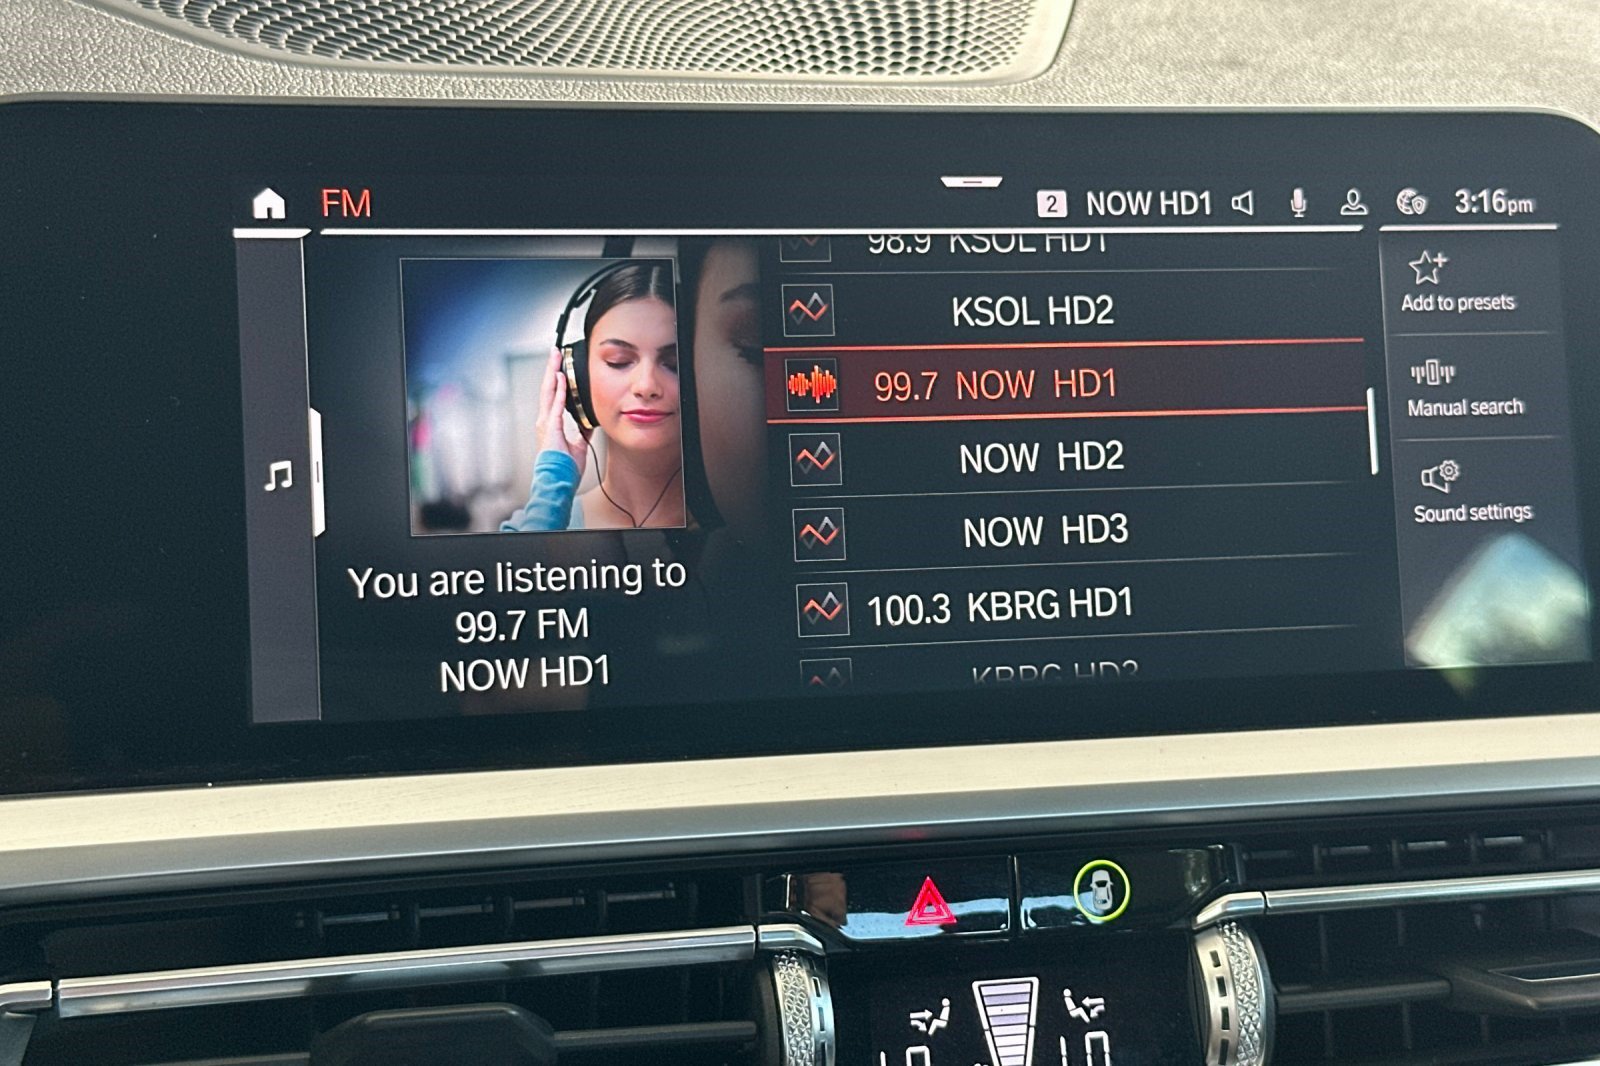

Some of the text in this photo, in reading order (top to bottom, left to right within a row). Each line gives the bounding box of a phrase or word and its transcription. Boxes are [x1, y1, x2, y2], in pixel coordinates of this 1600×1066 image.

[323, 189, 370, 217] FM
[1047, 191, 1210, 215] 2 NOW HD1
[869, 236, 930, 253] 98.9
[951, 235, 1036, 253] KSOL
[953, 295, 1114, 326] KSOL HD2
[1402, 295, 1515, 313] Add to presets
[875, 368, 1114, 401] 99.7 NOW HD1
[1408, 398, 1523, 416] Manual search
[961, 440, 1124, 473] NOW HD2
[1415, 503, 1533, 522] Sound settings
[965, 513, 1128, 547] NOW HD3
[348, 558, 685, 598] You are listening to
[868, 587, 1131, 625] 100.3 KBRG HD1
[456, 608, 588, 643] 99.7 FM
[441, 655, 608, 692] NOW HD1
